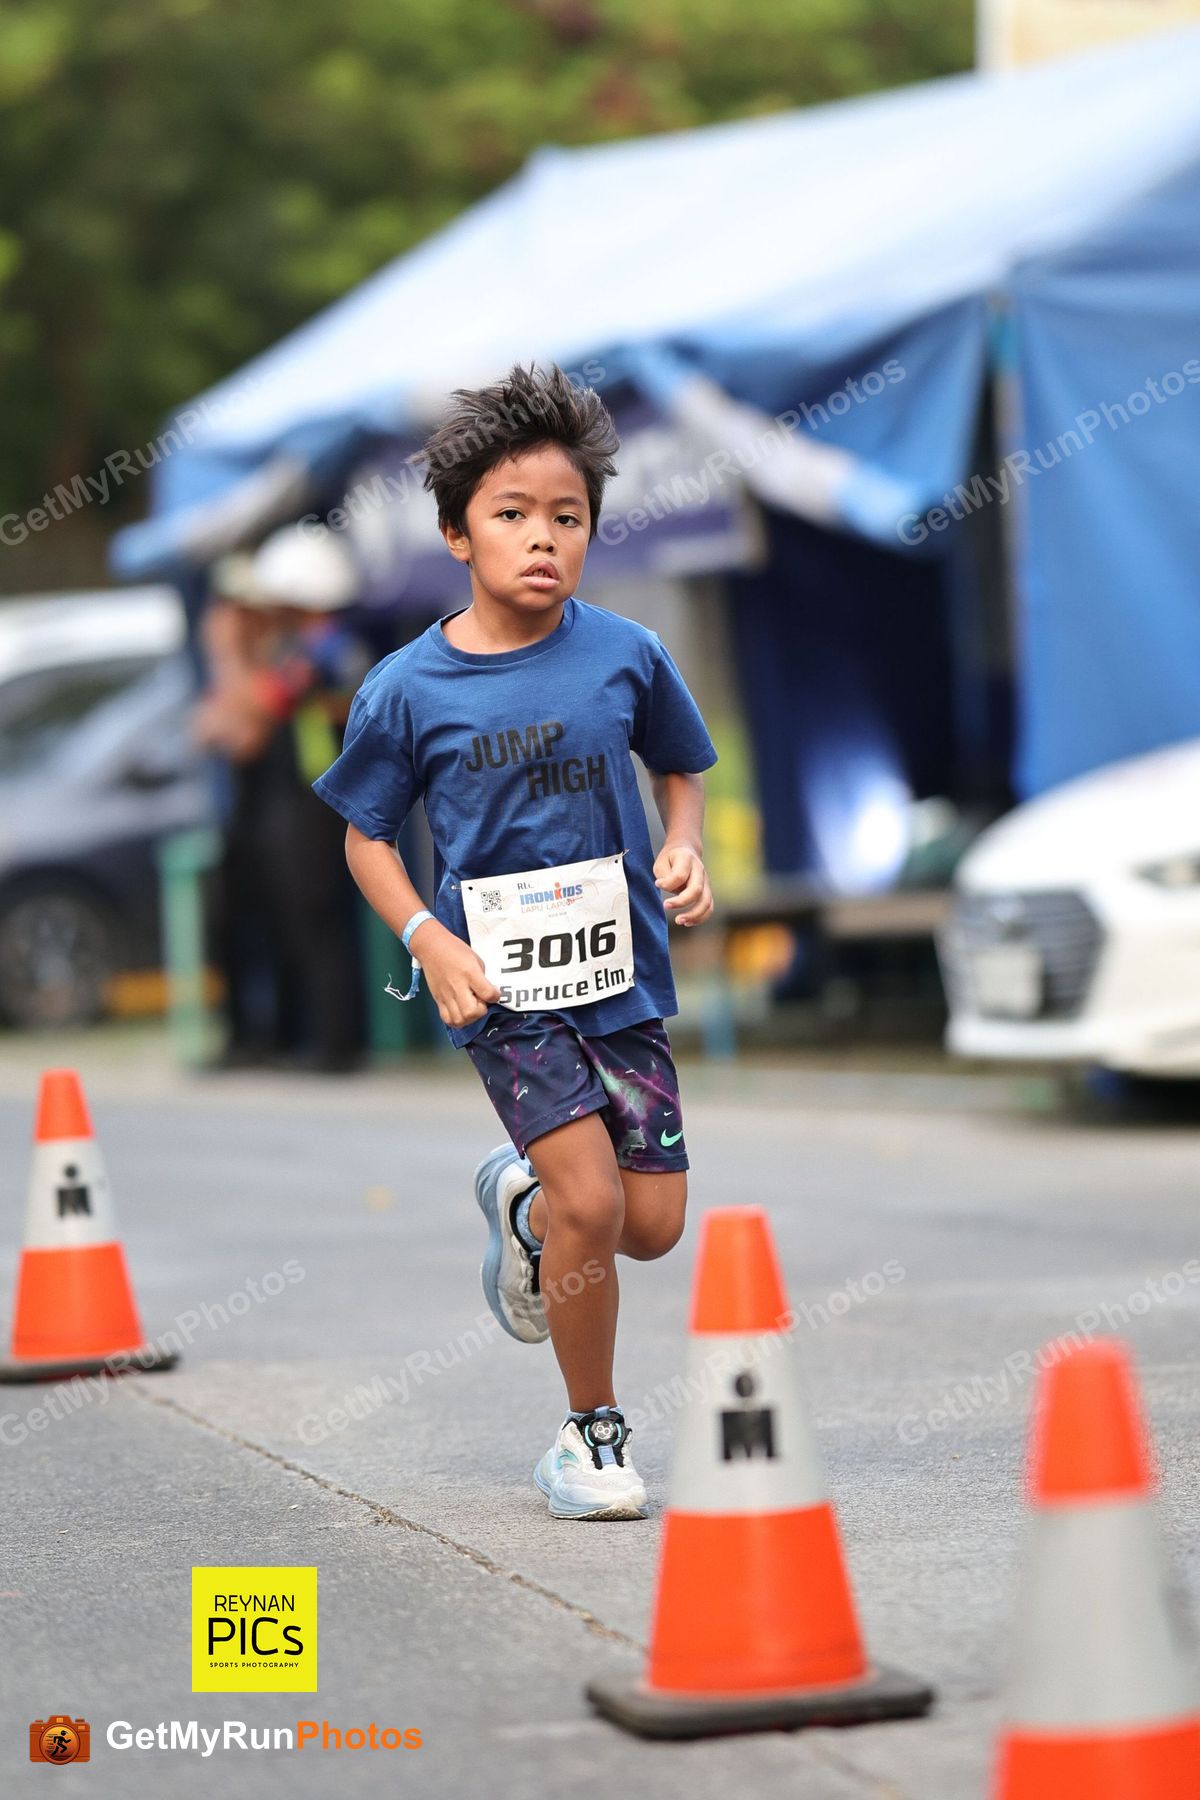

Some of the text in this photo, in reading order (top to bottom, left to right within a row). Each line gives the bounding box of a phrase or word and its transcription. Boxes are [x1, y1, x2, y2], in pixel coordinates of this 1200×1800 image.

[465, 720, 564, 772] JUMP
[526, 753, 606, 801] HIGH
[501, 919, 617, 974] 3016
[500, 968, 626, 1008] Spruce Elm
